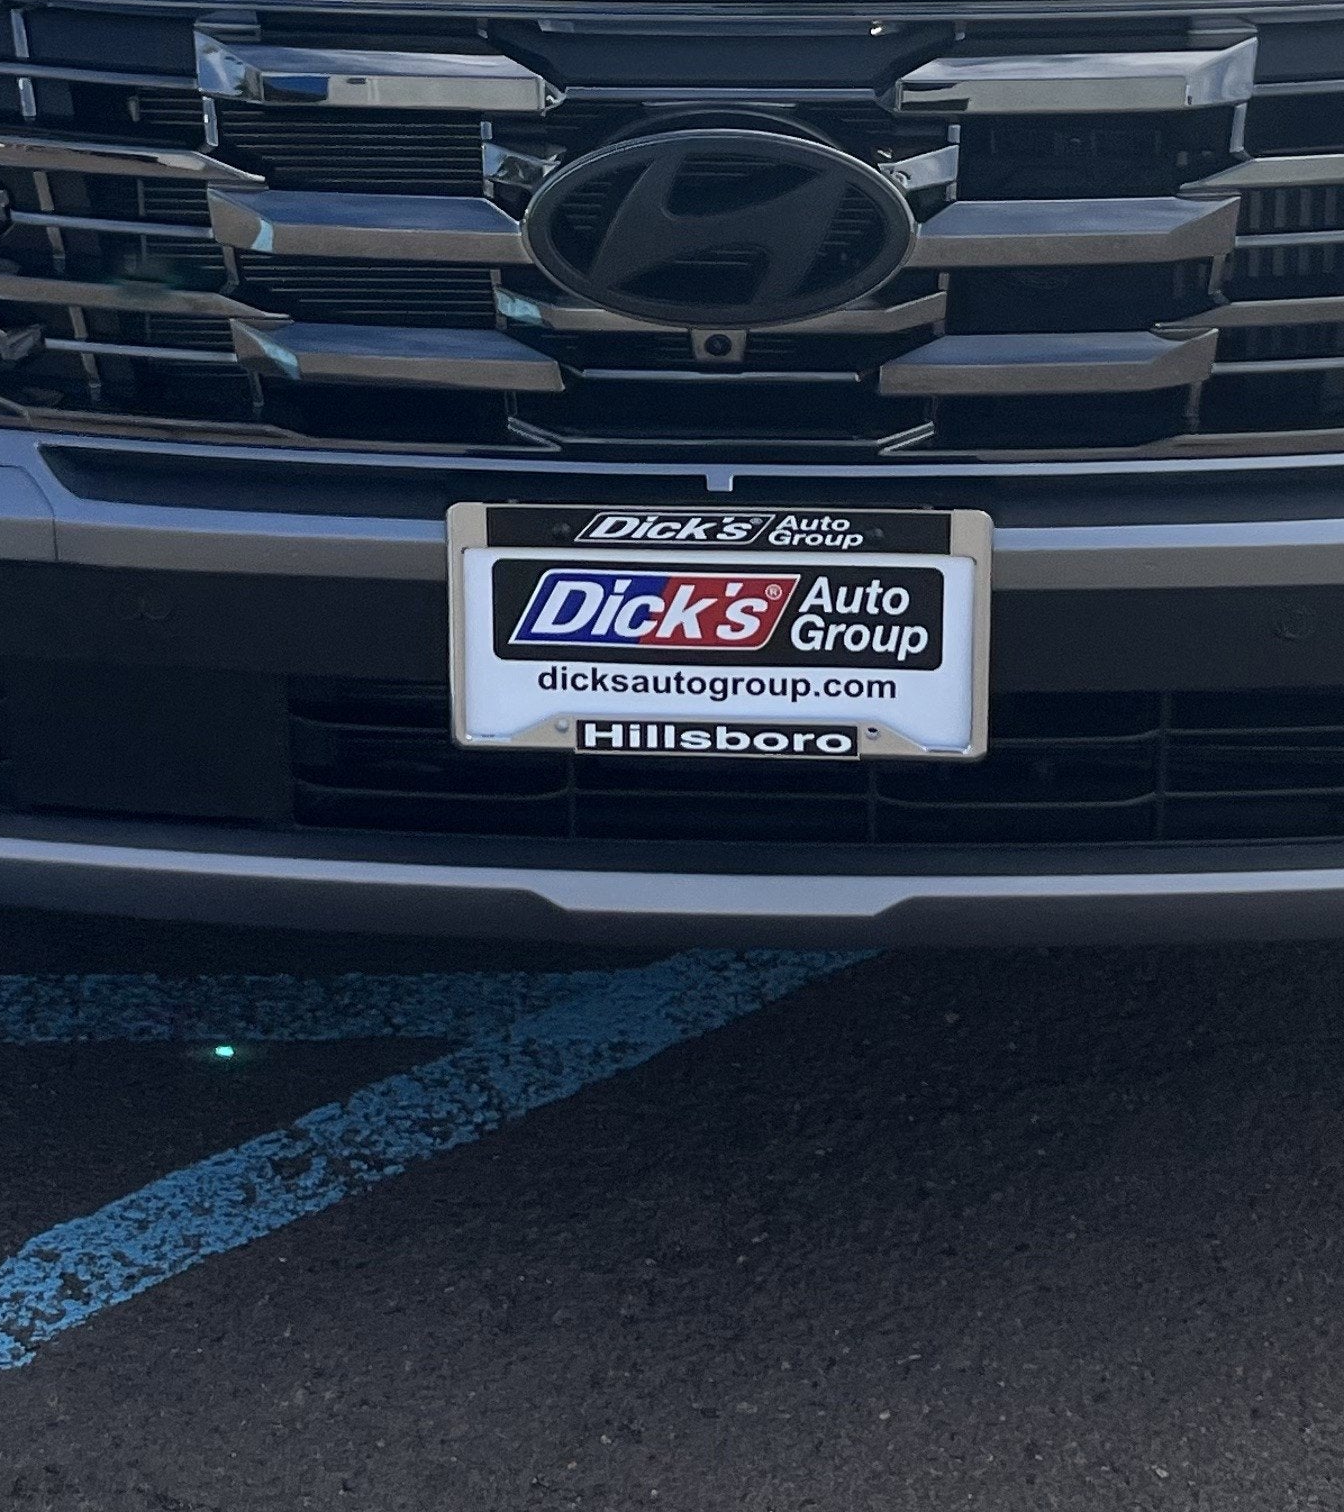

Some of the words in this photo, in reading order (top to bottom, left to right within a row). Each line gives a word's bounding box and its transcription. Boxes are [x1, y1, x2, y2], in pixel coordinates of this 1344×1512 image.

[768, 529, 864, 550] Group
[775, 514, 851, 532] Auto
[798, 576, 910, 616] Auto
[790, 615, 929, 661] Group
[537, 665, 897, 703] dicksautogroup.com
[584, 722, 852, 754] Hillsboro
